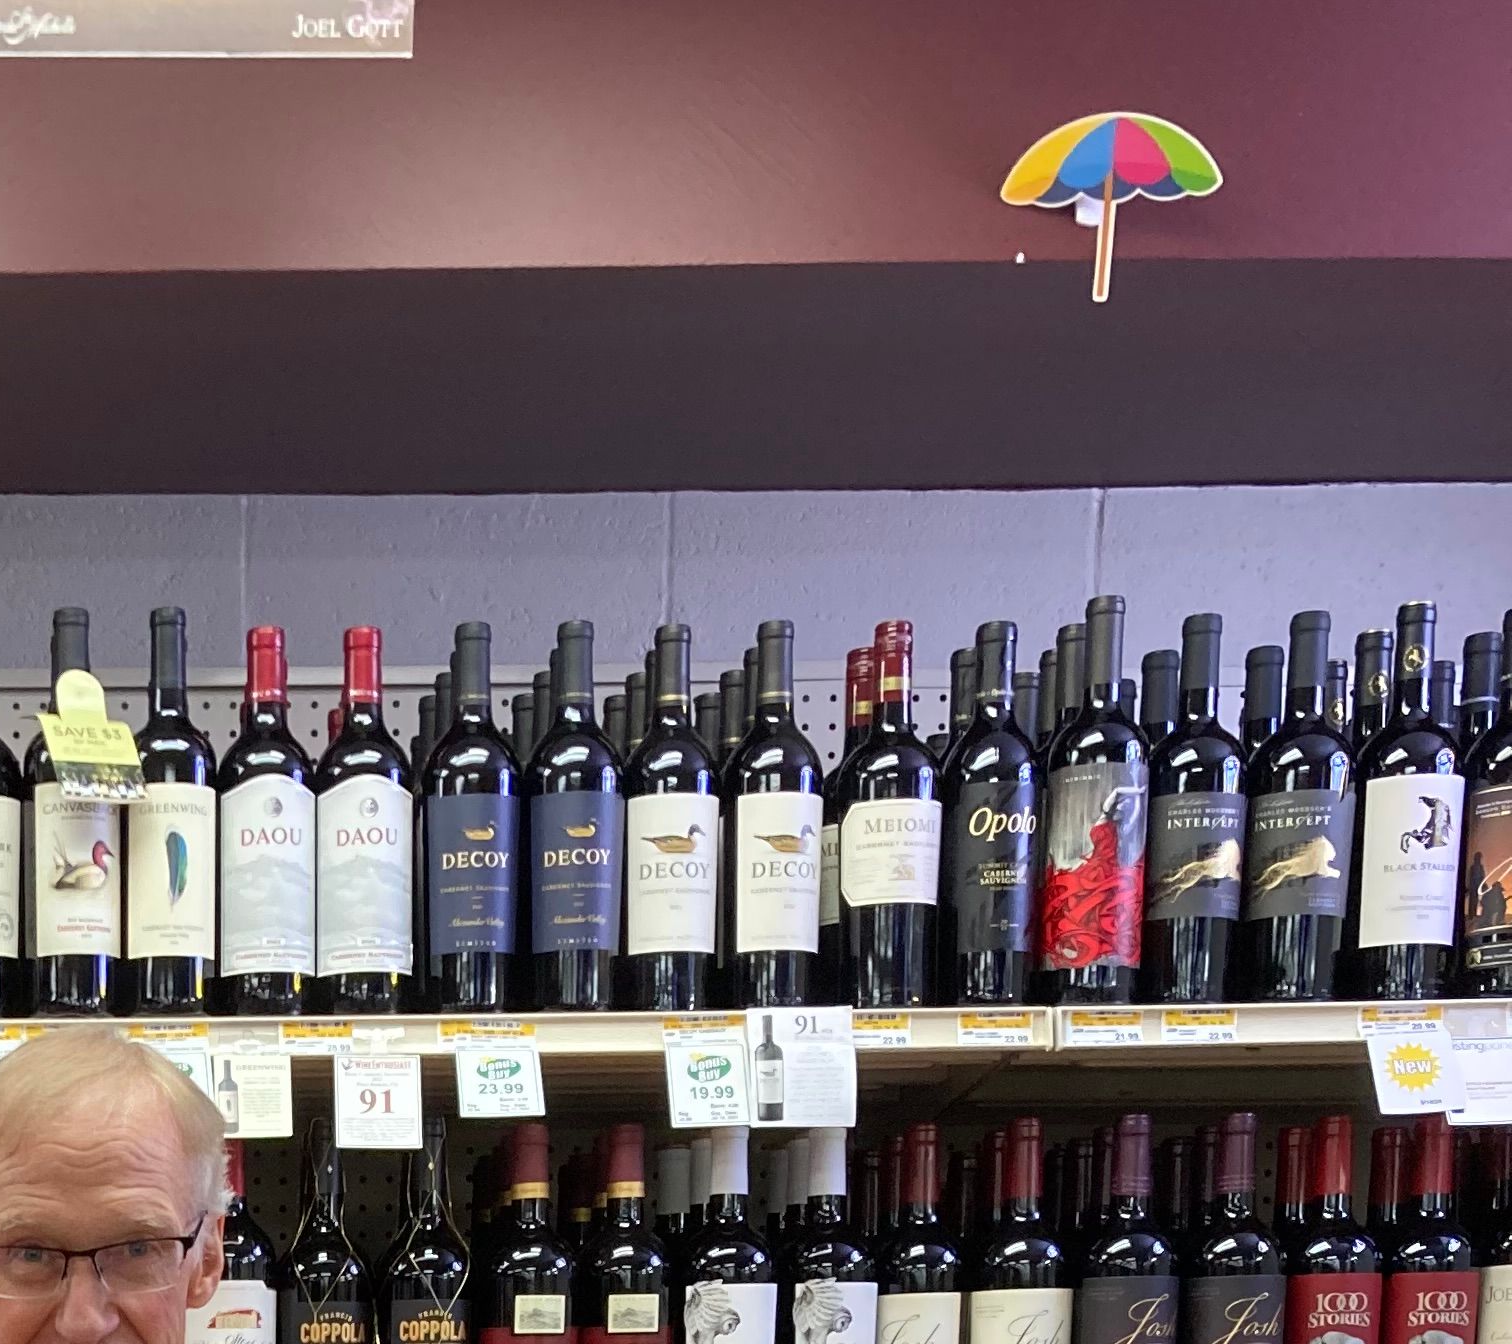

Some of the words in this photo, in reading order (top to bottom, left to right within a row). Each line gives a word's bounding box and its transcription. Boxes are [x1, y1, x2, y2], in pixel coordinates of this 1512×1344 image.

[292, 15, 340, 38] JOEL
[346, 14, 402, 40] GOTT
[53, 724, 98, 739] SAVE
[139, 802, 208, 817] GREENWING
[864, 817, 936, 835] MEIOMI
[969, 806, 1037, 841] Opolo
[1167, 816, 1239, 830] INTERCEPT
[1255, 814, 1332, 832] INTERCEPT
[241, 828, 302, 847] DAOU
[337, 828, 398, 847] DAOU
[443, 852, 510, 870] DECOY
[545, 849, 612, 868] DECOY
[1384, 862, 1418, 873] BLACK
[639, 861, 711, 880] DECOY
[751, 861, 817, 880] DECOY
[794, 1014, 818, 1034] 91
[1393, 1059, 1432, 1074] New
[478, 1083, 524, 1095] 23.99
[690, 1085, 735, 1100] 19.99
[360, 1088, 395, 1114] 91
[1315, 1292, 1368, 1312] 1000
[1415, 1290, 1467, 1311] 1000
[1308, 1311, 1370, 1328] STORIES
[1407, 1310, 1470, 1327] STORIES
[300, 1321, 364, 1343] COPPOLA
[398, 1319, 466, 1342] COPPOLA
